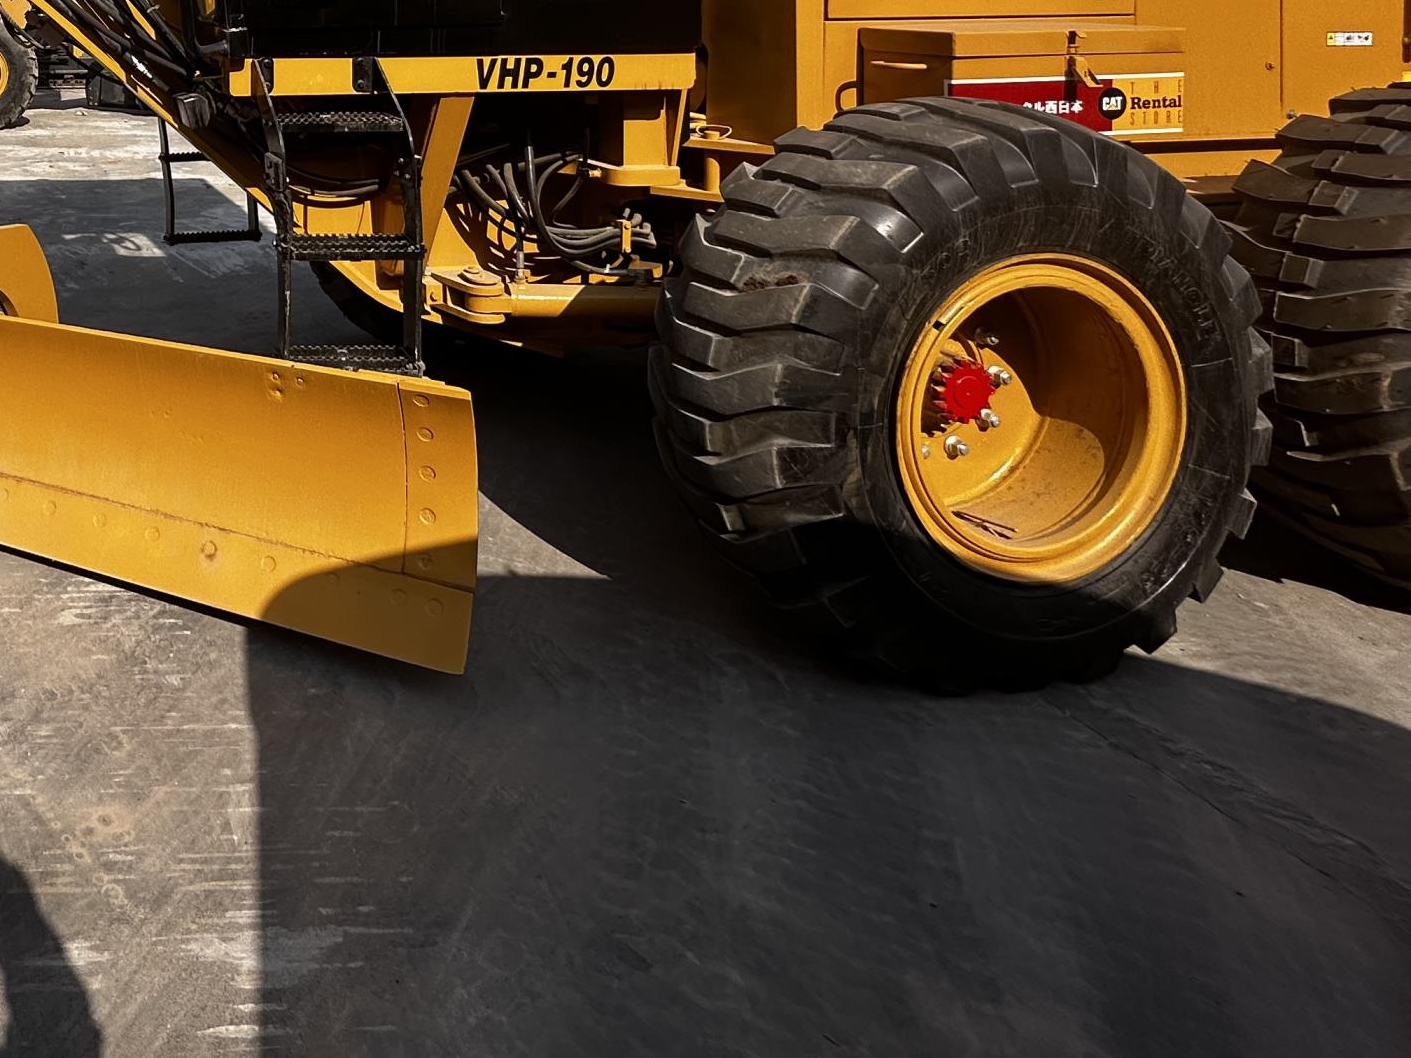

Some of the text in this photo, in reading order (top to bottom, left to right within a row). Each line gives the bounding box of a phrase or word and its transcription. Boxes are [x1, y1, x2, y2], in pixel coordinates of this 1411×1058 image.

[476, 56, 615, 90] VHP-190
[1130, 79, 1182, 94] THE
[1102, 96, 1123, 111] CAT
[1130, 94, 1182, 110] Rental
[1130, 110, 1182, 126] STORE
